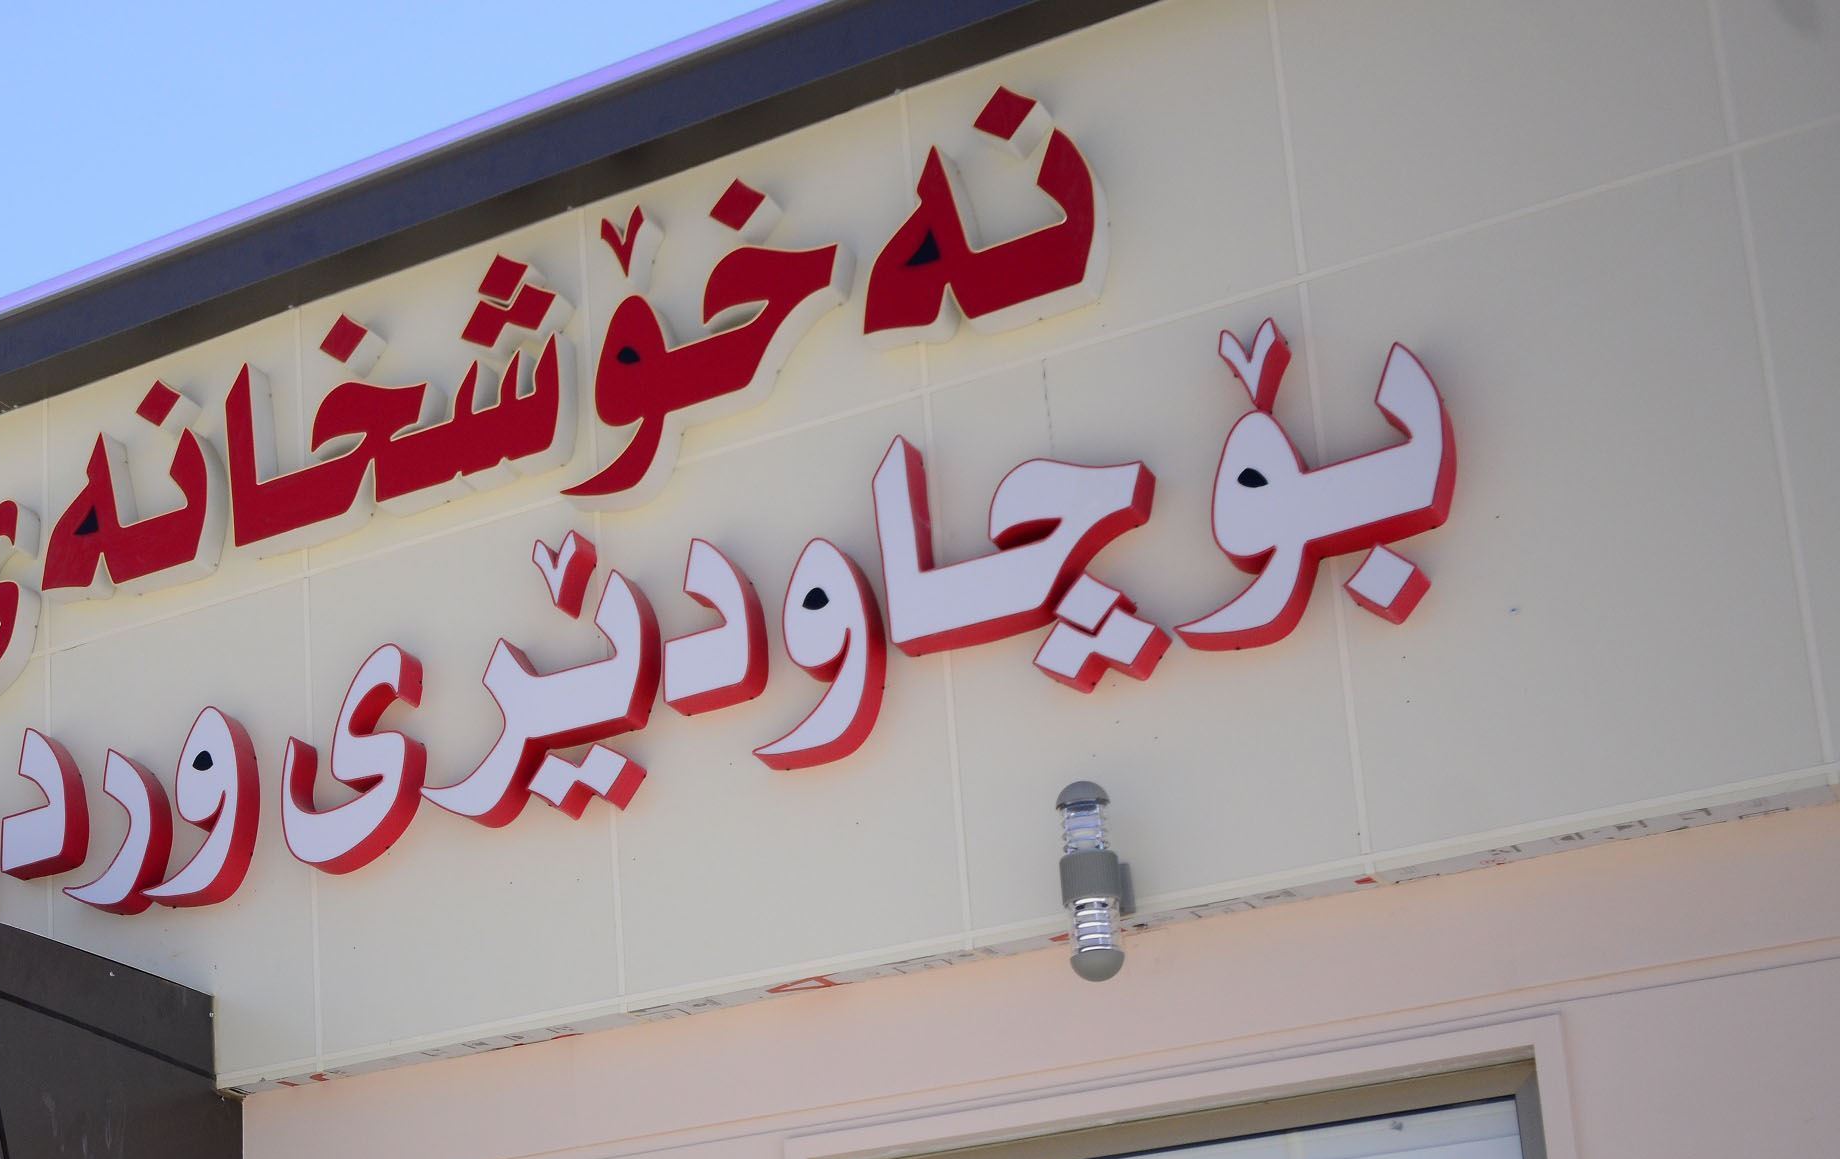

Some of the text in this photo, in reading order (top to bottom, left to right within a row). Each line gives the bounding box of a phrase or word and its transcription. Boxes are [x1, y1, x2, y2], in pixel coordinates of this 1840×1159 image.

[1172, 318, 1456, 652] بۆ
[0, 705, 256, 915] ورد
[283, 434, 1171, 875] چاودێری
